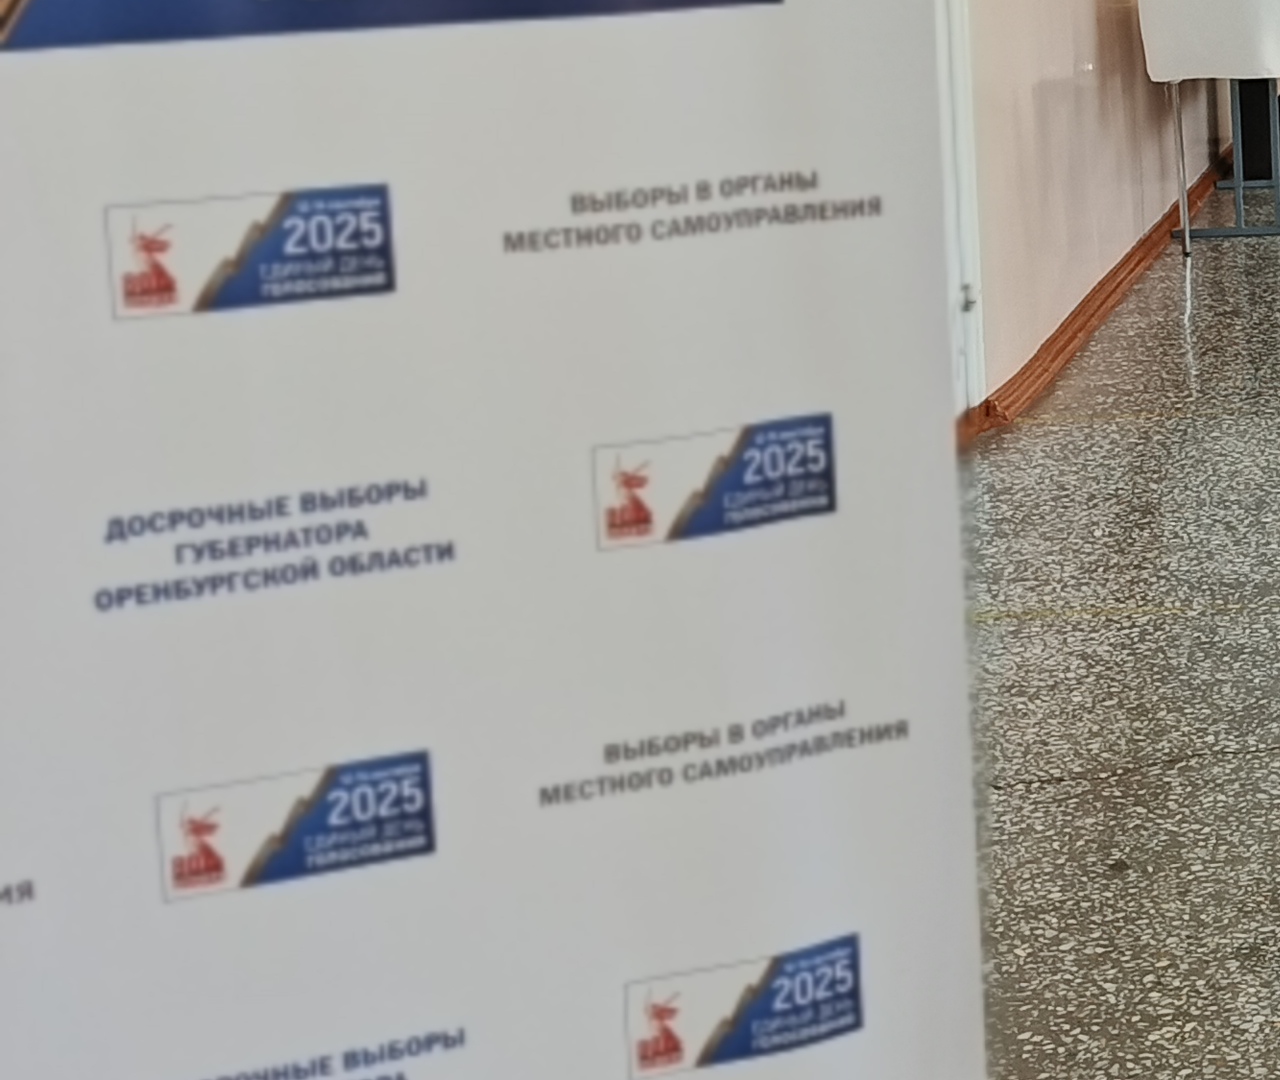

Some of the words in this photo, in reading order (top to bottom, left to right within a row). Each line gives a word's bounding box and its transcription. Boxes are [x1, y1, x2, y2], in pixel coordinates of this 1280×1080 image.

[570, 183, 689, 214] ВЫБОРЫ
[696, 180, 712, 201] В
[719, 170, 819, 198] ОРГАНЫ
[283, 210, 384, 255] 2025
[502, 222, 643, 253] МЕСТНОГО
[650, 195, 883, 241] САМОУПРАВЛЕНИЯ
[743, 439, 826, 485] 2025
[103, 495, 290, 545] ДОСРОЧНЫЕ
[299, 478, 429, 513] ВЫБОРЫ
[175, 520, 368, 564] ГУБЕРНАТОРА
[93, 560, 321, 613] ОРЕНБУРГСКОЙ
[327, 540, 456, 578] ОБЛАСТИ
[603, 728, 720, 764] ВЫБОРЫ
[728, 723, 744, 744] В
[752, 699, 847, 740] ОРГАНЫ
[538, 767, 675, 808] МЕСТНОГО
[682, 719, 909, 784] САМОУПРАВЛЕНИЯ
[327, 776, 425, 827] 2025
[772, 959, 854, 1012] 2025
[341, 1027, 466, 1072] ВЫБОРЫ
